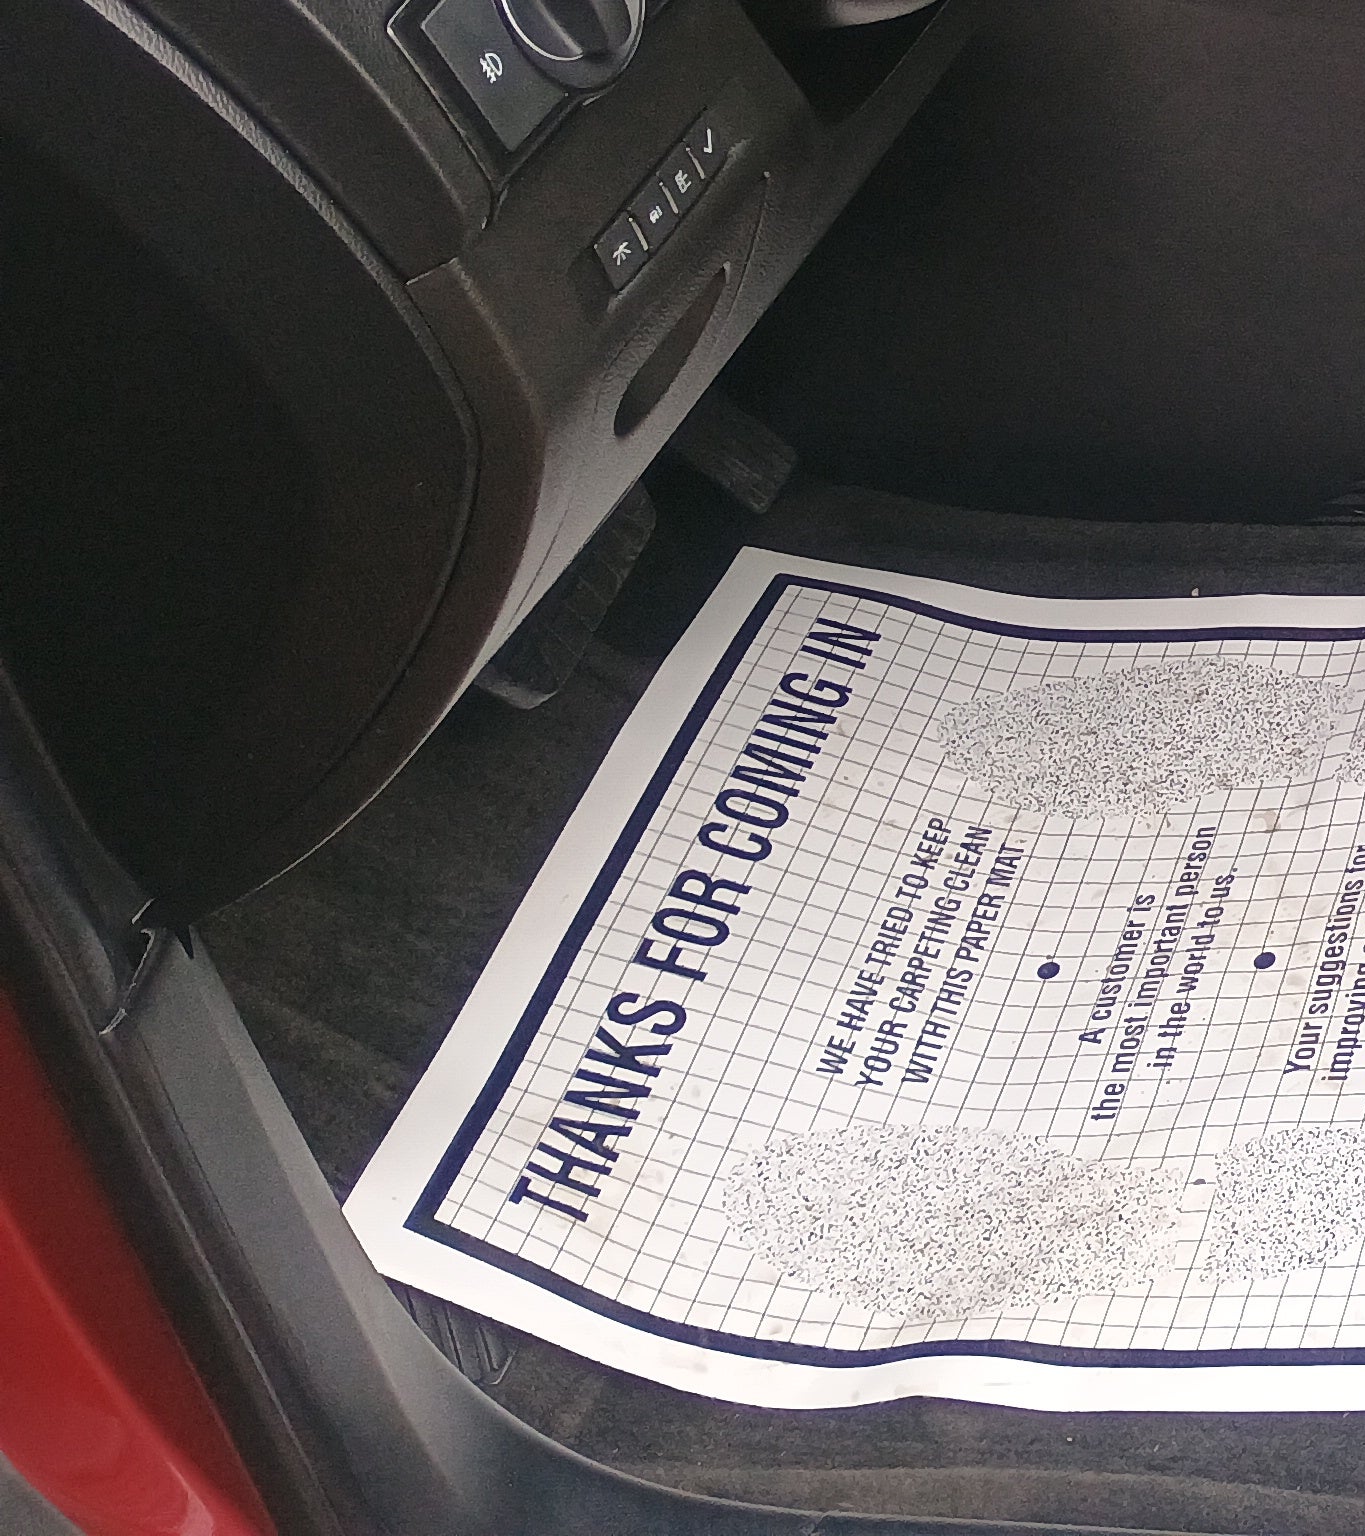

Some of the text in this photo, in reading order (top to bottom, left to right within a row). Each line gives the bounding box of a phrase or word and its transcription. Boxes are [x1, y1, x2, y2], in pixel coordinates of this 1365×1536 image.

[508, 617, 882, 1223] THANKS FOR COMING IN
[816, 817, 952, 1075] WE HAVE TRIED TO KEEP
[855, 825, 993, 1086] YOUR CARPETING CLEAN
[901, 842, 1025, 1084] WITH THIS PAPER MAT
[1078, 894, 1155, 1044] A customer is
[1090, 826, 1217, 1121] the most important person
[1147, 866, 1238, 1068] in the world to us.
[1282, 1021, 1323, 1075] Your
[1308, 879, 1364, 1015] suggestions
